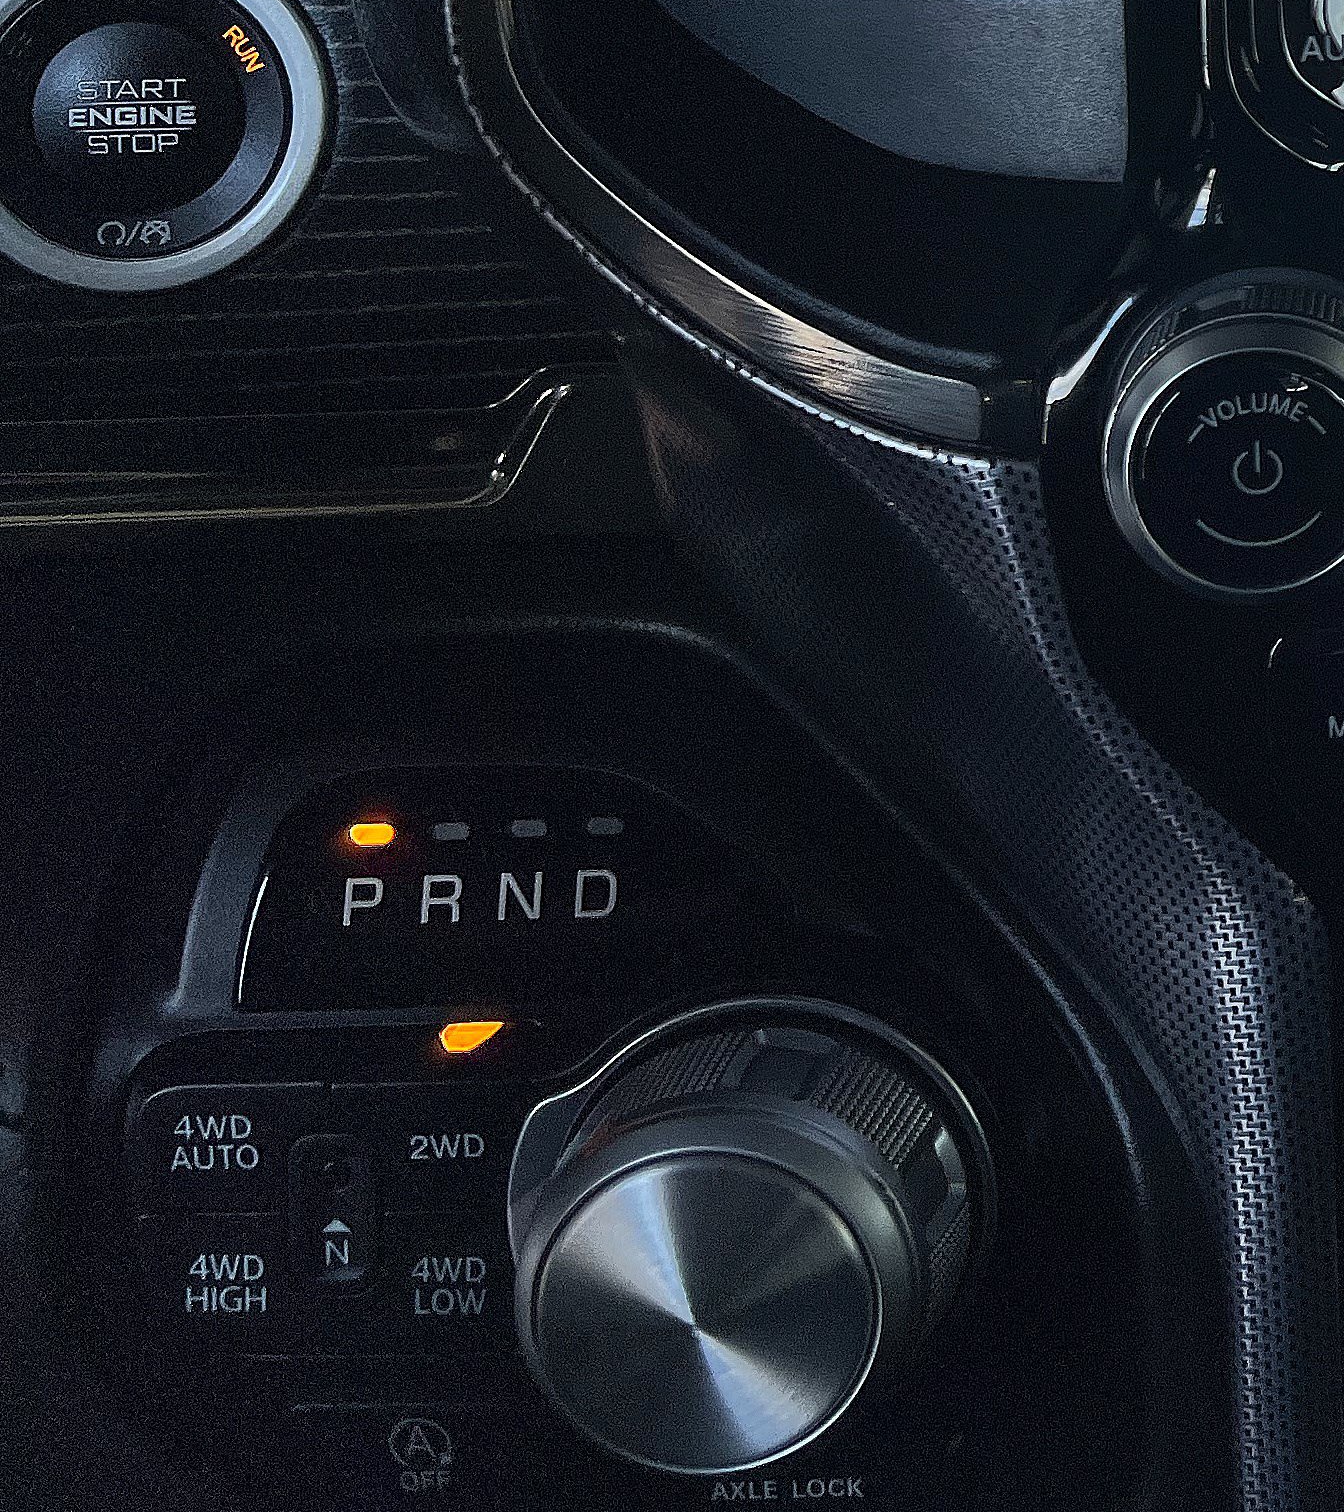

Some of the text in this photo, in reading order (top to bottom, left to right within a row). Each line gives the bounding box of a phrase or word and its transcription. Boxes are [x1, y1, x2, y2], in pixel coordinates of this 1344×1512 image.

[222, 25, 265, 74] RUN
[76, 78, 187, 101] START
[68, 104, 197, 128] ENGINE
[88, 132, 179, 155] STOP
[1200, 392, 1308, 429] VOLUME
[342, 869, 618, 926] P R N D
[173, 1115, 252, 1140] 4WD
[170, 1144, 259, 1171] AUTO
[410, 1133, 485, 1160] 2WD
[325, 1239, 350, 1265] N
[189, 1254, 264, 1282] 4WD
[411, 1256, 486, 1284] 4WD
[184, 1286, 267, 1313] HIGH
[414, 1288, 485, 1316] LOW
[399, 1472, 451, 1492] OFF
[711, 1478, 864, 1502] AXLE LOCK
